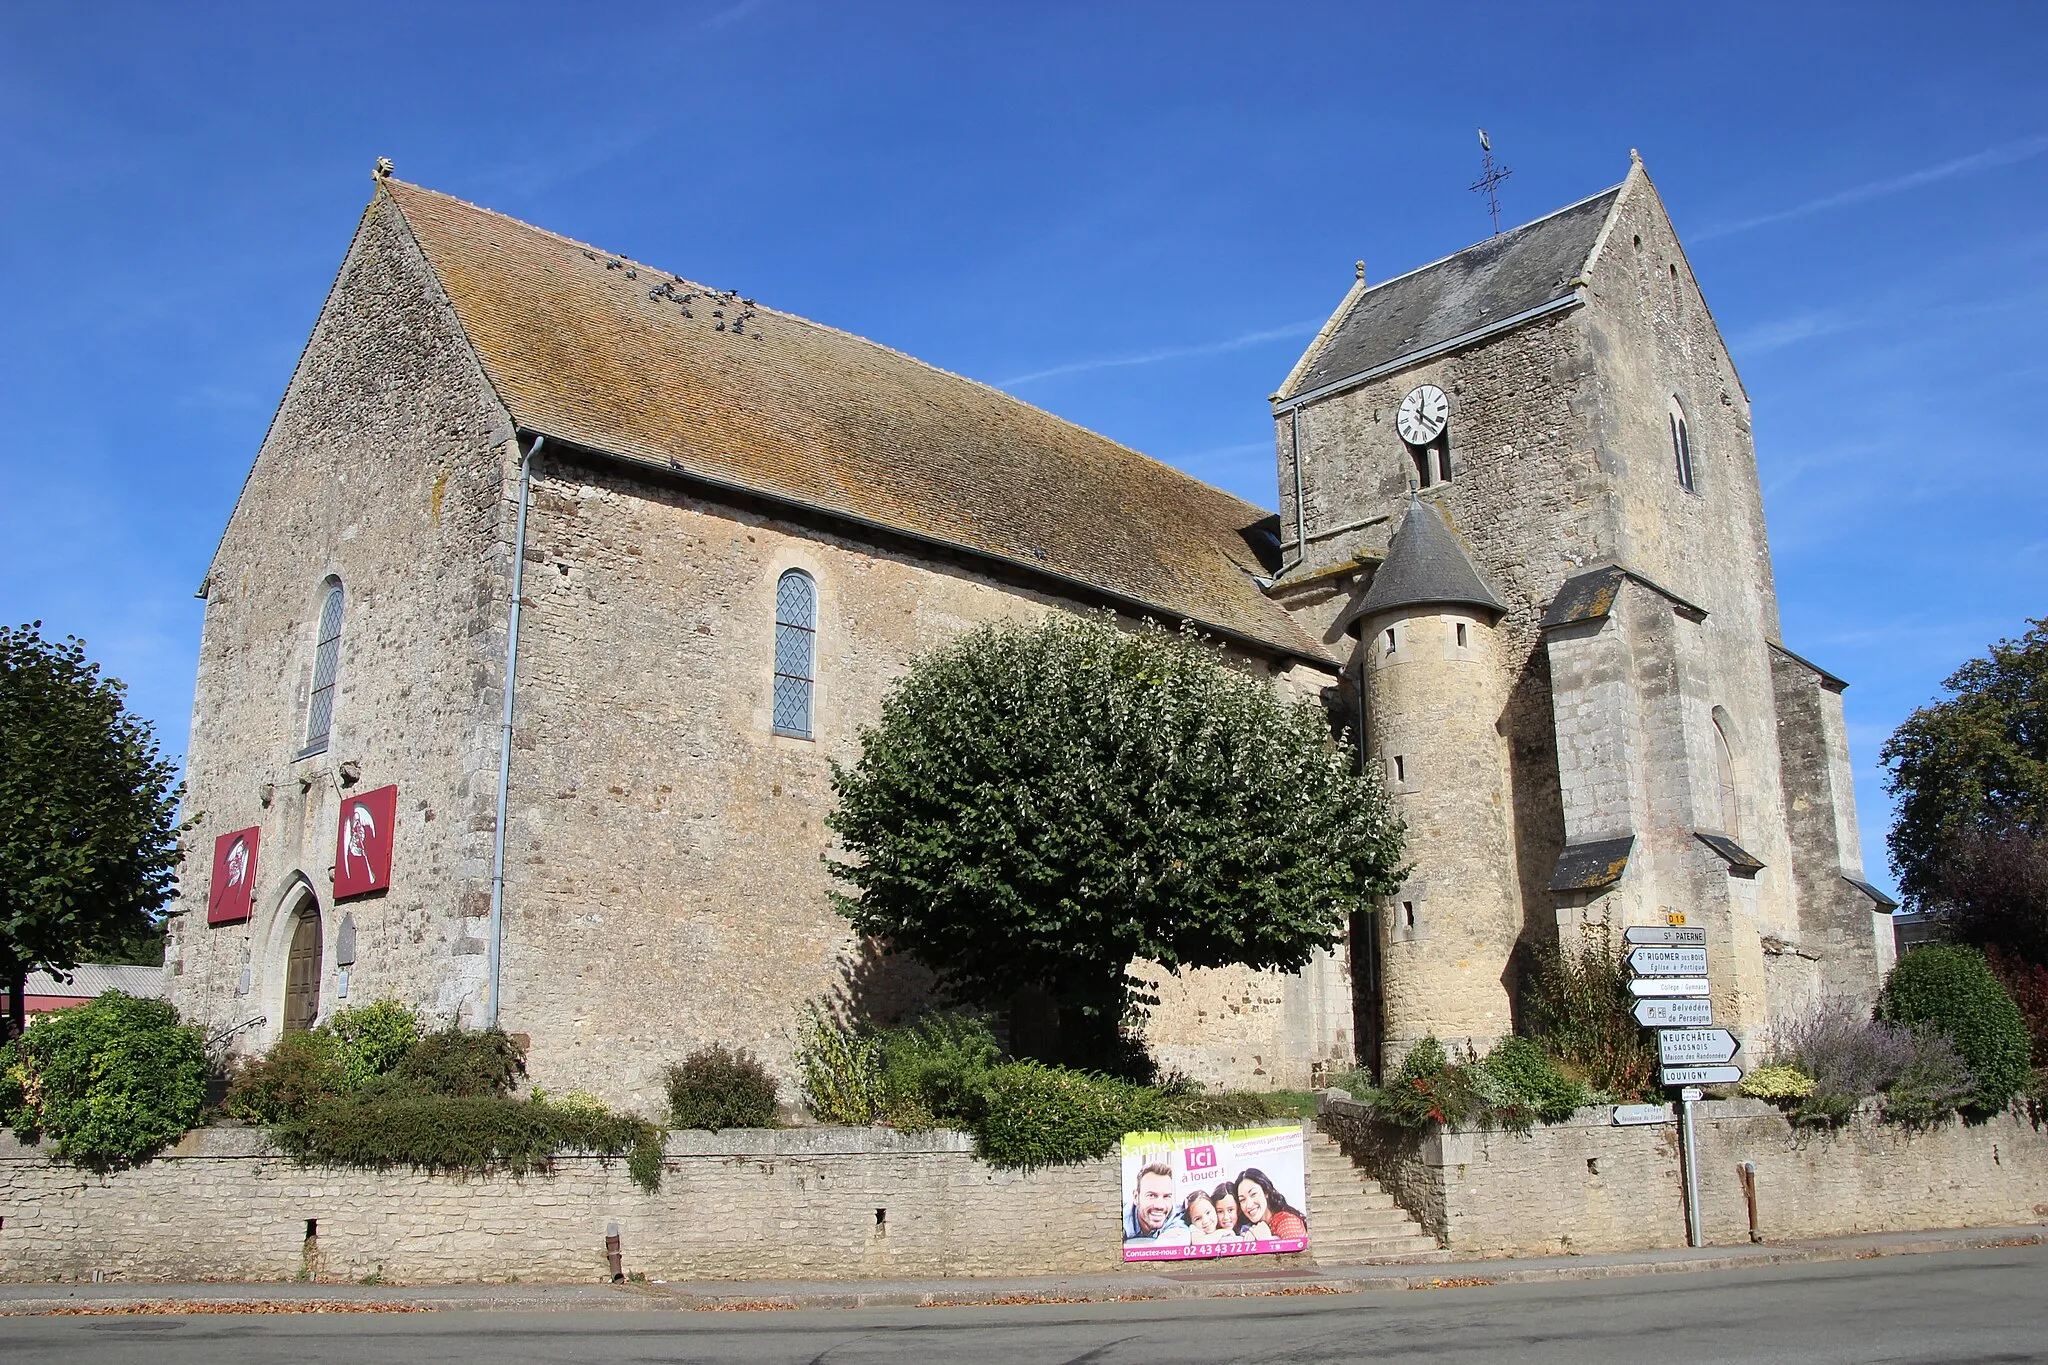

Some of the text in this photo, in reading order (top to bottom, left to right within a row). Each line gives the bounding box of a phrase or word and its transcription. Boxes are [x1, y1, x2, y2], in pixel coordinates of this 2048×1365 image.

[1668, 915, 1685, 923] D 19
[1676, 932, 1703, 941] PATERNE
[1647, 952, 1680, 961] RIGOMER
[1680, 963, 1705, 972] Portique
[1685, 983, 1707, 991] Gymnase
[1672, 1003, 1709, 1012] Belvédère
[1668, 1013, 1710, 1023] de Perseigne
[1663, 1032, 1716, 1042] NEUFCHÂTEL
[1673, 1043, 1708, 1051] SAOSNOIS
[1696, 1052, 1727, 1060] Randonnées
[1666, 1071, 1708, 1080] LOUVIGNY
[1121, 1132, 1230, 1157] Sarthe Habitat
[1190, 1147, 1212, 1167] ici
[1181, 1174, 1188, 1183] à
[1190, 1170, 1219, 1181] louer
[1125, 1249, 1178, 1258] Contactez-nous
[1183, 1246, 1197, 1256] 02
[1199, 1244, 1213, 1255] 43
[1214, 1243, 1228, 1254] 43
[1229, 1243, 1243, 1253] 72
[1244, 1241, 1257, 1252] 72
